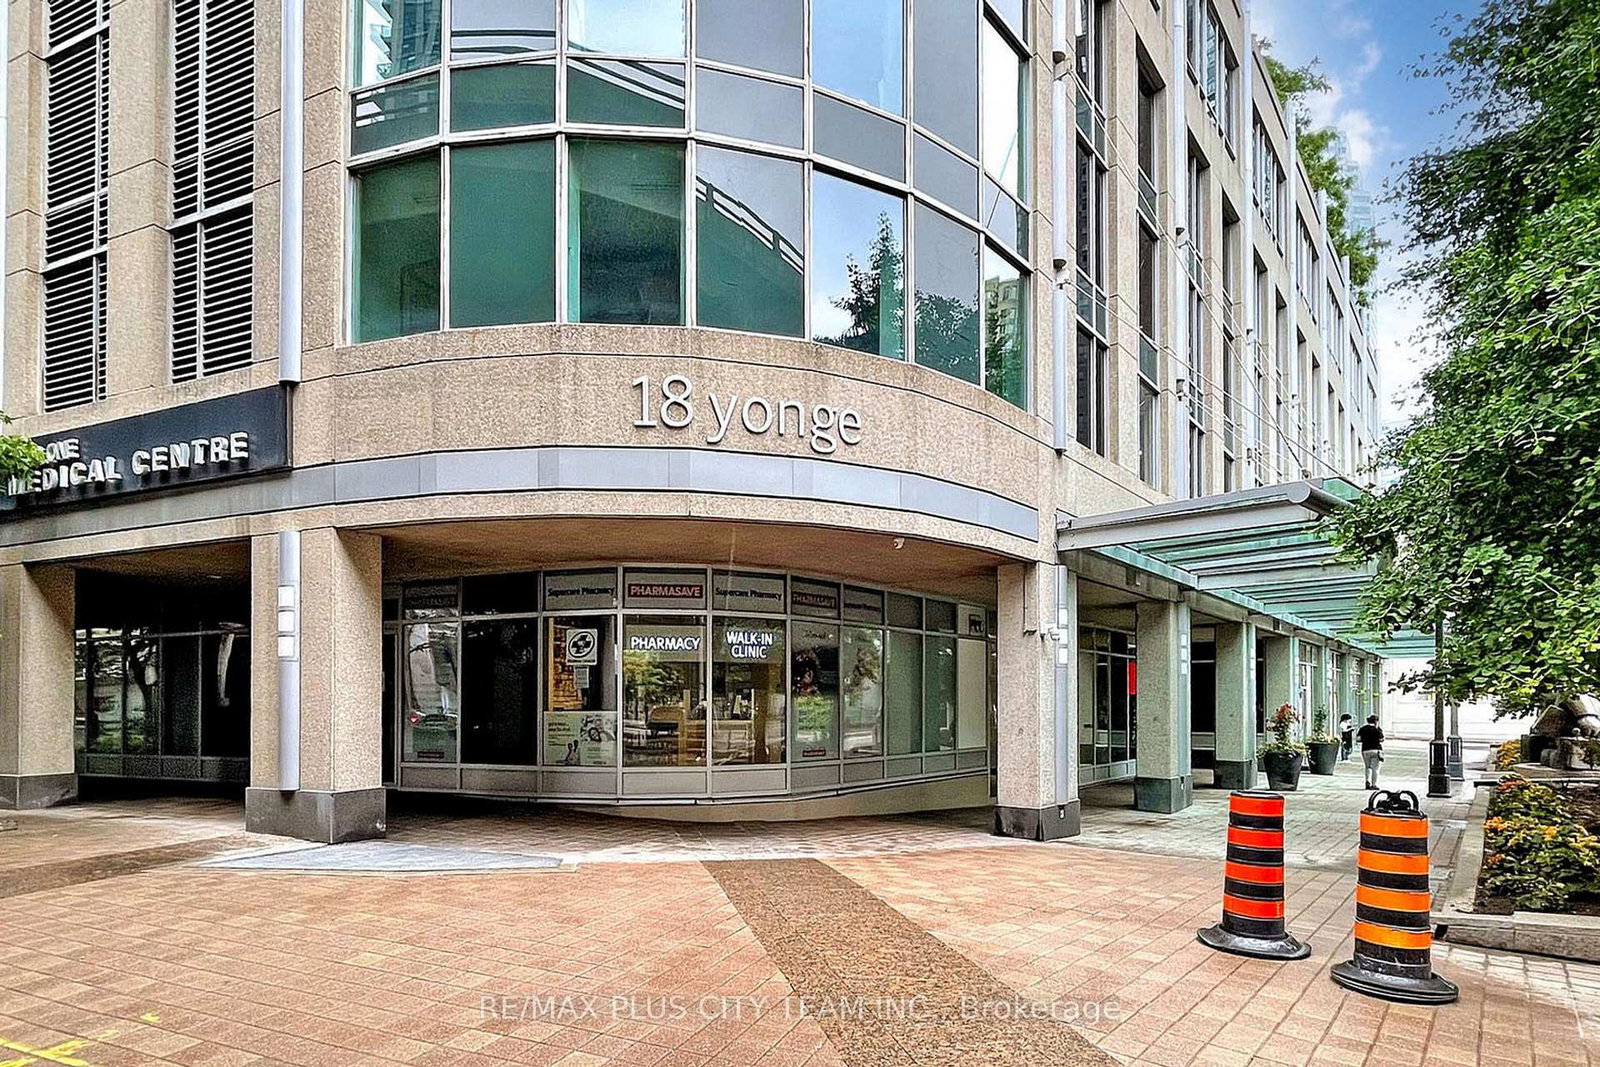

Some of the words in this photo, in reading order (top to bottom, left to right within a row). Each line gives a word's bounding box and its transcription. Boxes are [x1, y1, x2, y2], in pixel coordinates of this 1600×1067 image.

[632, 374, 694, 428] 18
[706, 392, 862, 454] yonge
[131, 431, 249, 475] CENTRE
[630, 586, 701, 597] PHARMASAVE
[750, 589, 782, 601] Pharmacy
[630, 636, 701, 650] PHARMACY
[726, 631, 773, 645] WALK-IN
[731, 644, 768, 659] CLINIC
